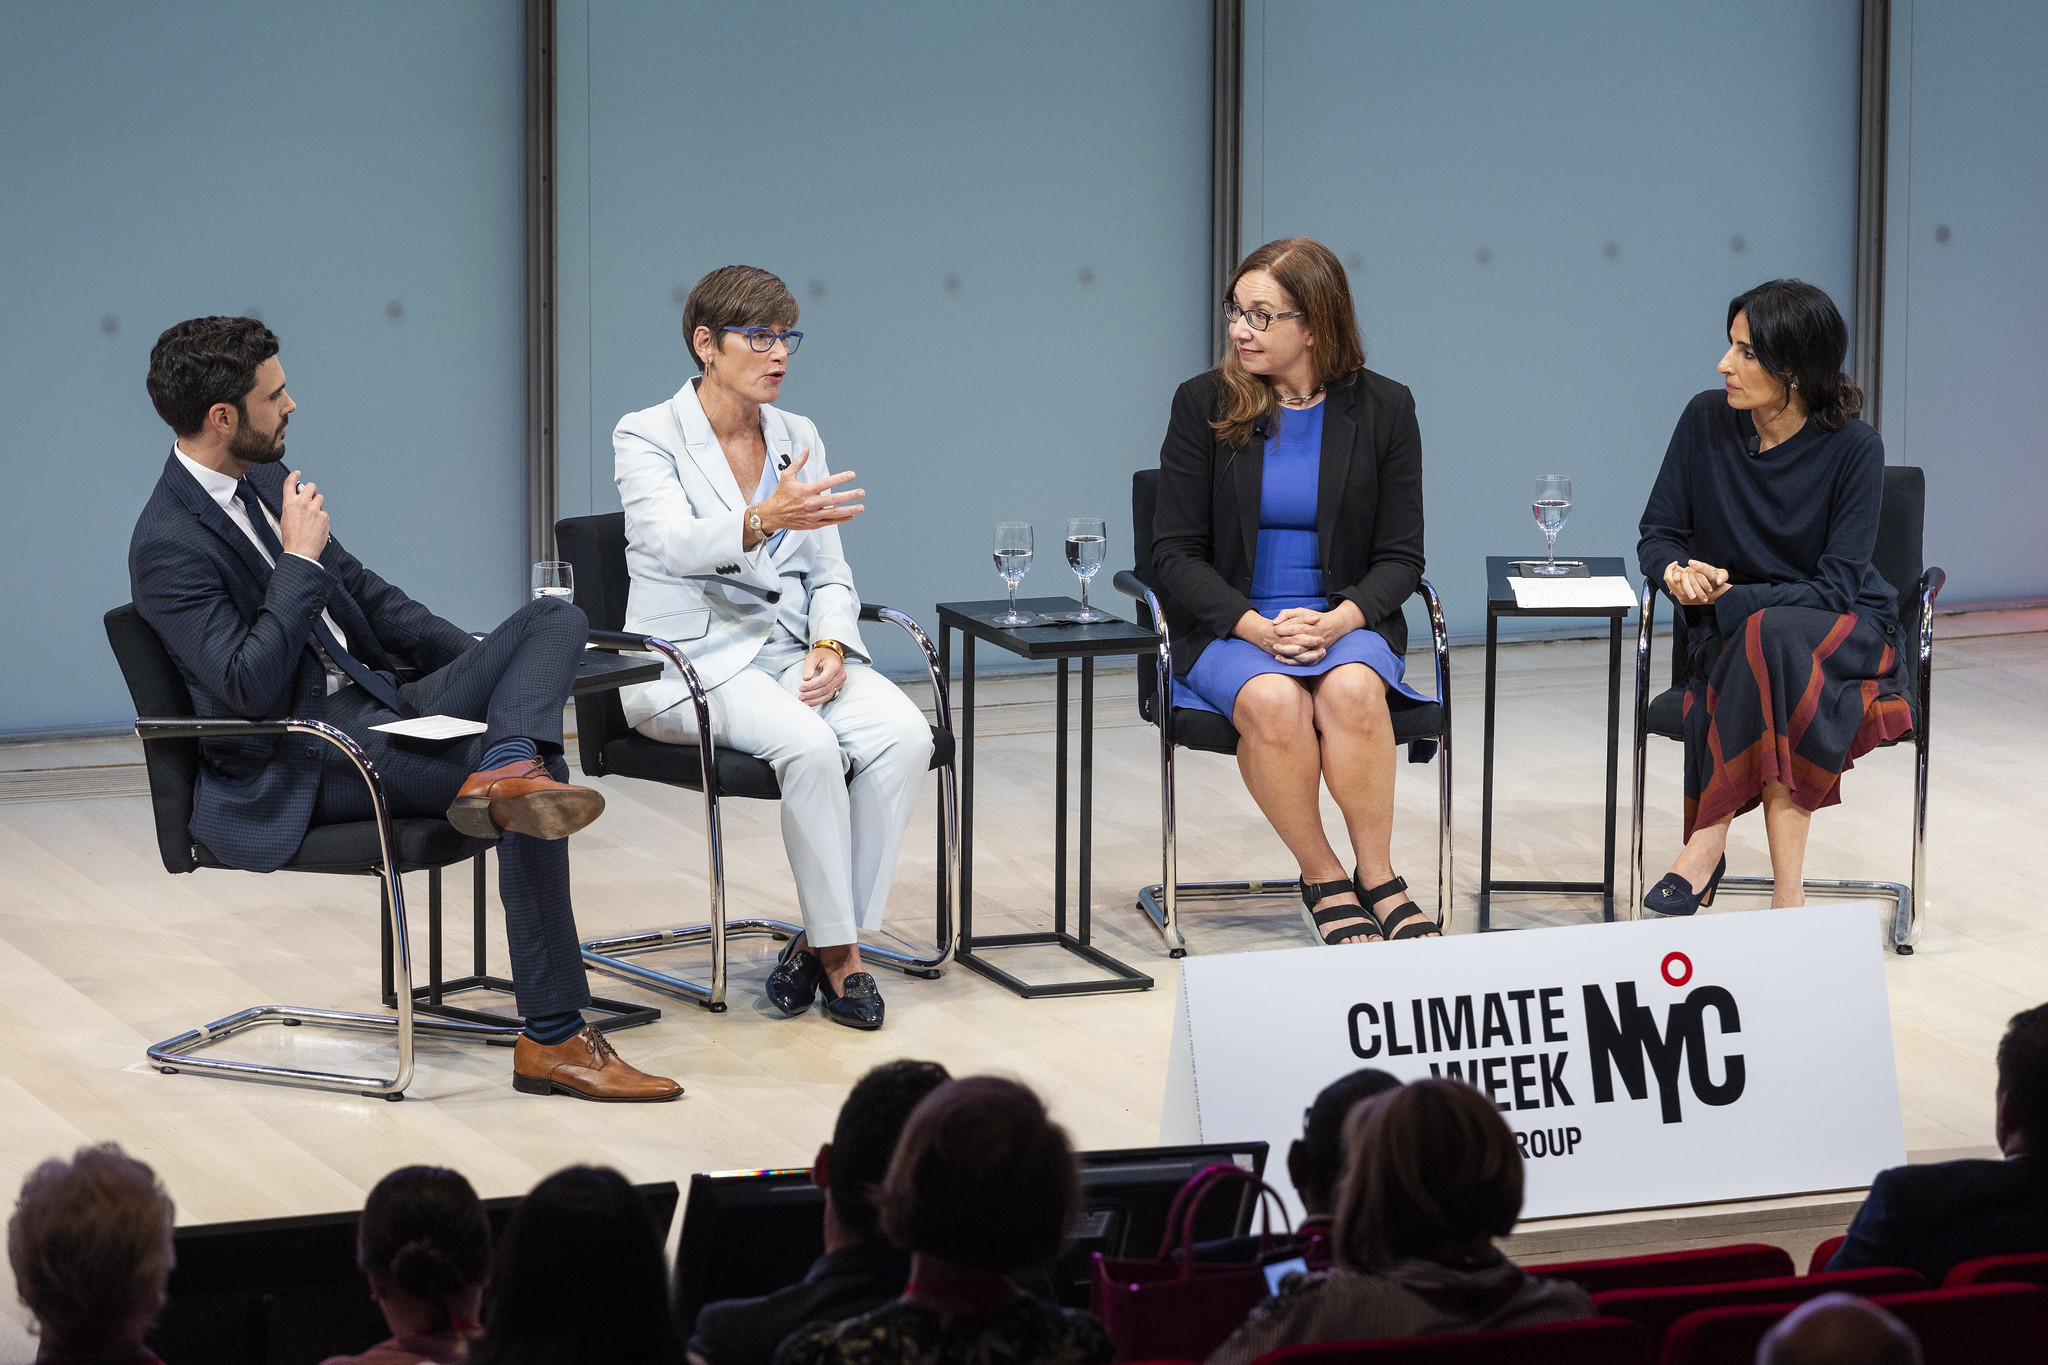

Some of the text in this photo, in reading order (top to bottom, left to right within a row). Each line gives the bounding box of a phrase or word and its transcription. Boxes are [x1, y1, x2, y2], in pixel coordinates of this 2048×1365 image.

[1347, 986, 1569, 1060] CLIMATE
[1581, 979, 1746, 1125] NYC
[1511, 1126, 1582, 1159] ROUP
